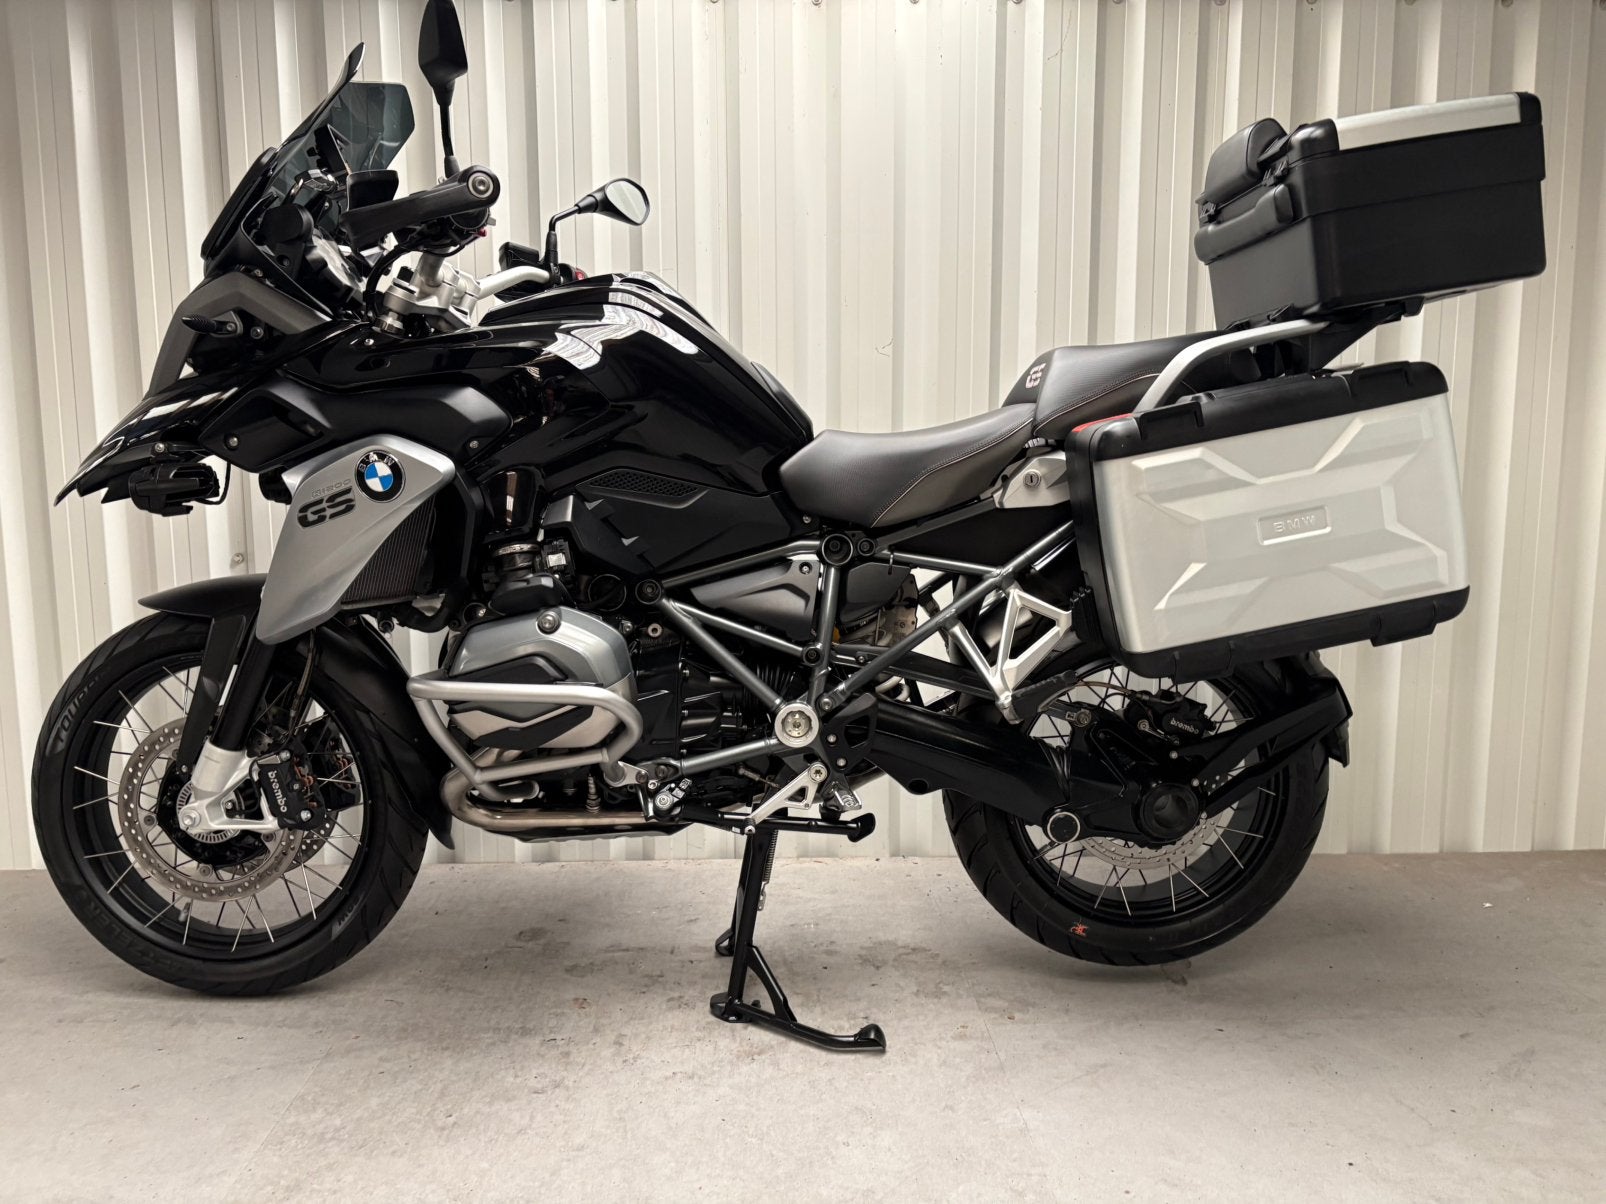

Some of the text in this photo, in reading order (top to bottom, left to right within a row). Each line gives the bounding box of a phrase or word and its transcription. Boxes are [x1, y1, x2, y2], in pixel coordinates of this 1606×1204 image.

[1025, 363, 1046, 389] GS
[359, 452, 395, 472] BMW
[297, 486, 355, 528] GS
[1273, 515, 1315, 533] BMW
[1170, 717, 1199, 735] brembo
[267, 770, 288, 813] brembo
